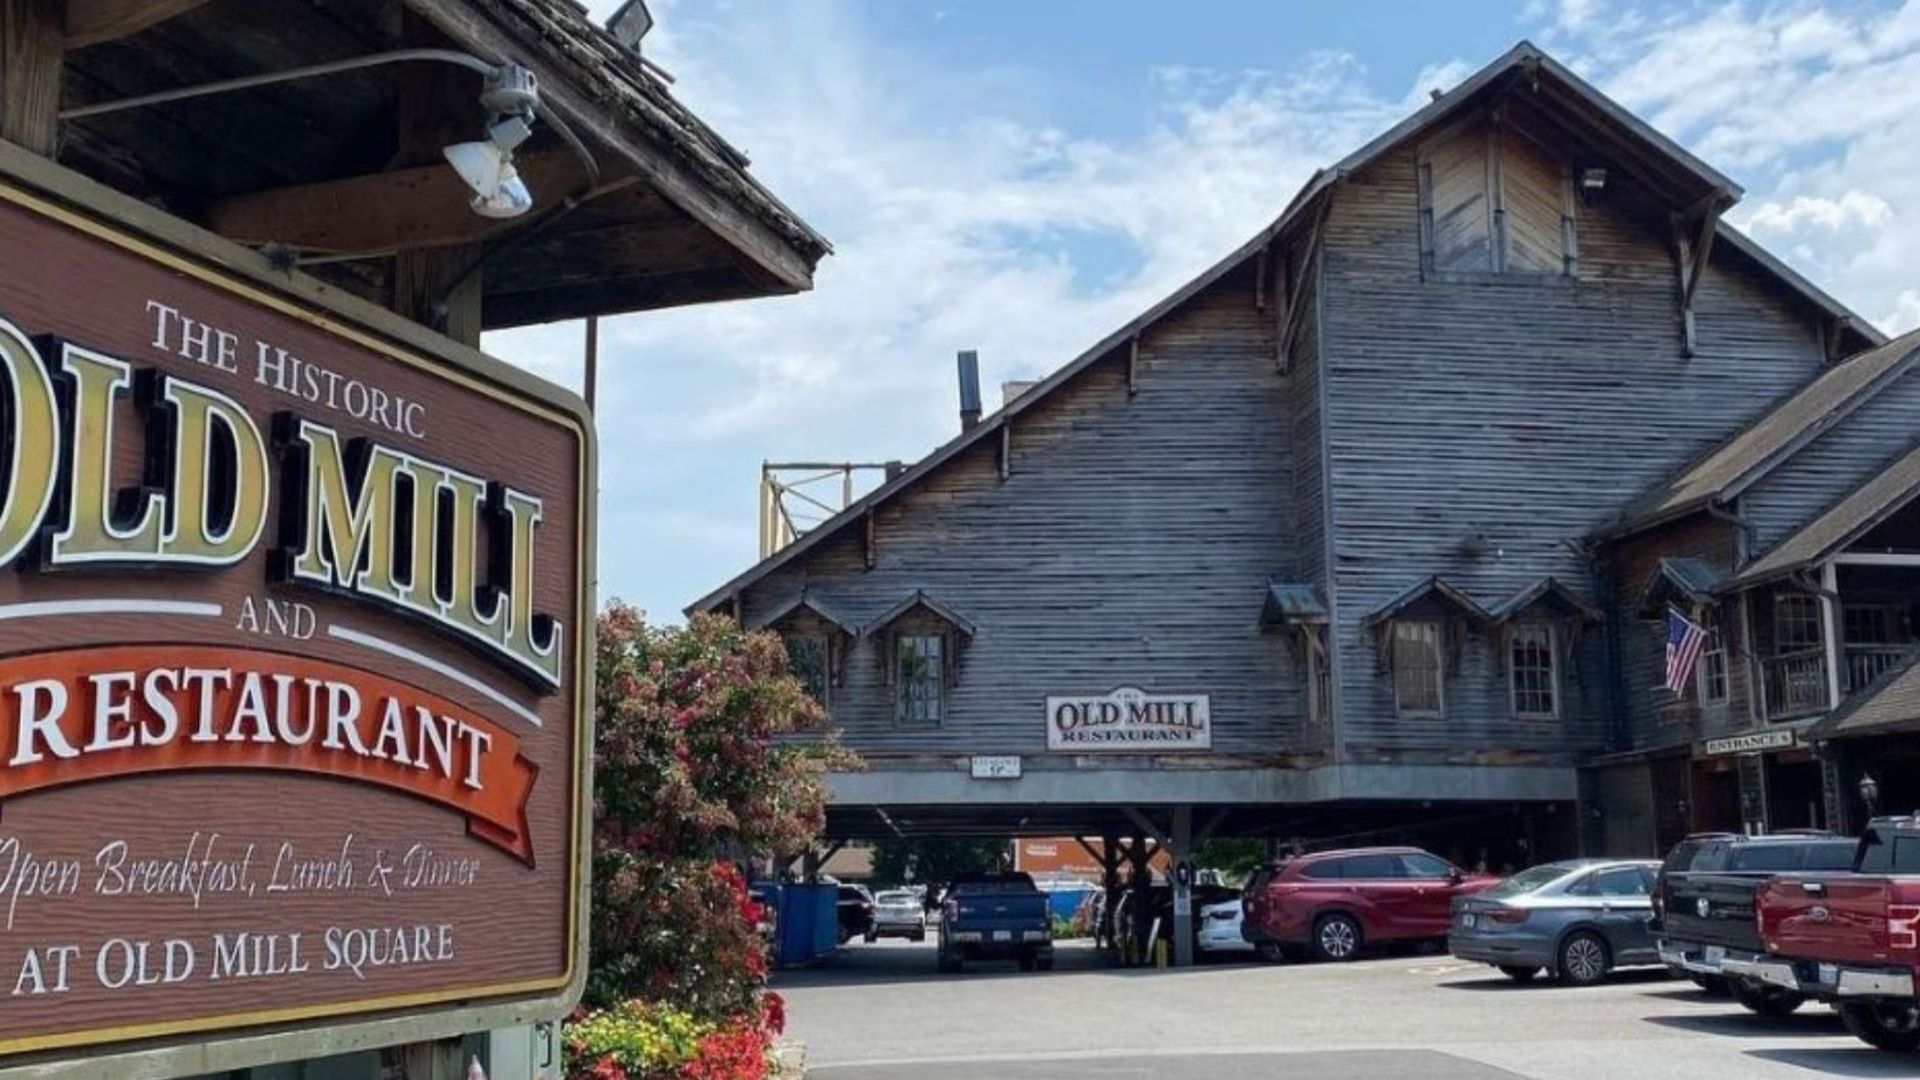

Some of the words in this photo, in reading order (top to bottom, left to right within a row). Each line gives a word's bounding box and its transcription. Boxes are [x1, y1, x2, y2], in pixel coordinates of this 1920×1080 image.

[146, 300, 238, 375] THE
[254, 341, 425, 438] HISTORIC
[294, 419, 563, 687] MILL
[236, 596, 316, 641] AND
[9, 667, 492, 790] RESTAURANT
[1056, 701, 1121, 731] OLD
[1128, 701, 1204, 730] MILL
[1061, 730, 1194, 742] RESTAURANT
[95, 831, 256, 909] Breakfast,
[267, 833, 353, 892] Lunch
[368, 850, 394, 896] &
[403, 841, 482, 887] Dinner
[12, 945, 81, 995] AT
[96, 938, 195, 988] OLD
[211, 932, 310, 979] MILL
[322, 924, 455, 980] SQUARE
